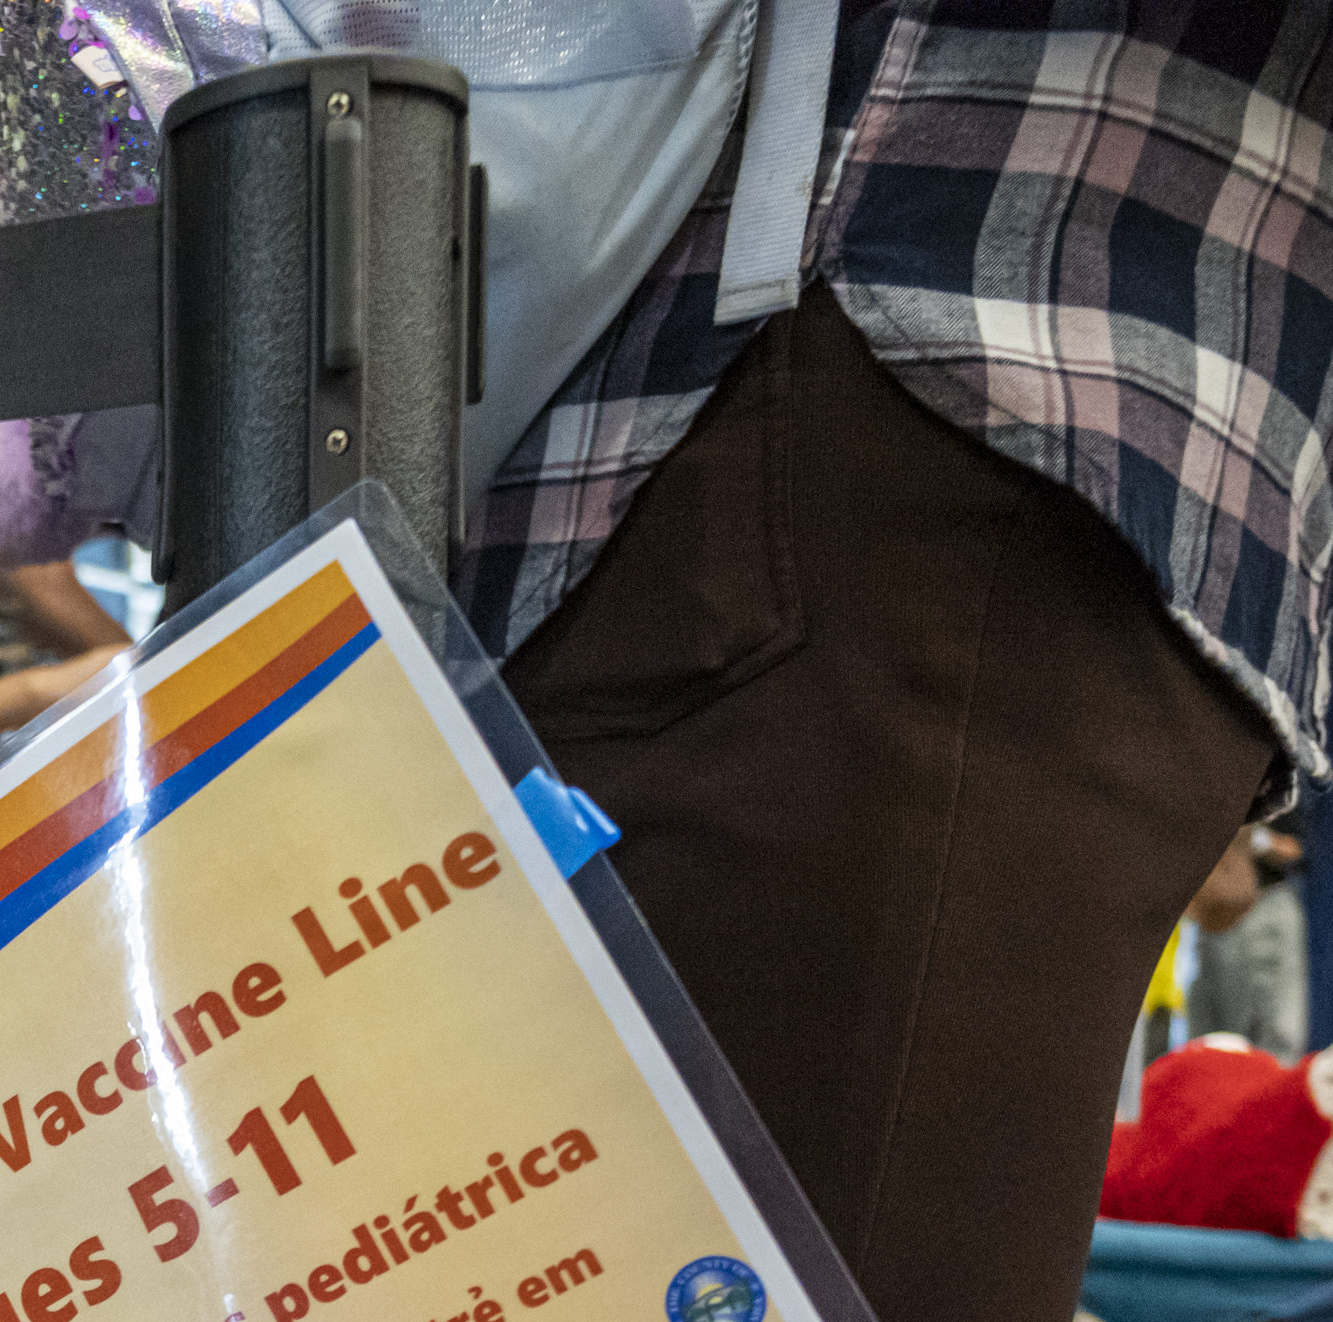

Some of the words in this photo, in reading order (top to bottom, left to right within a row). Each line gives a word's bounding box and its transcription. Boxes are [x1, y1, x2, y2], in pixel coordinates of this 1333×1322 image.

[289, 831, 503, 979] Line
[126, 1073, 358, 1264] 5-11
[515, 1247, 604, 1309] em
